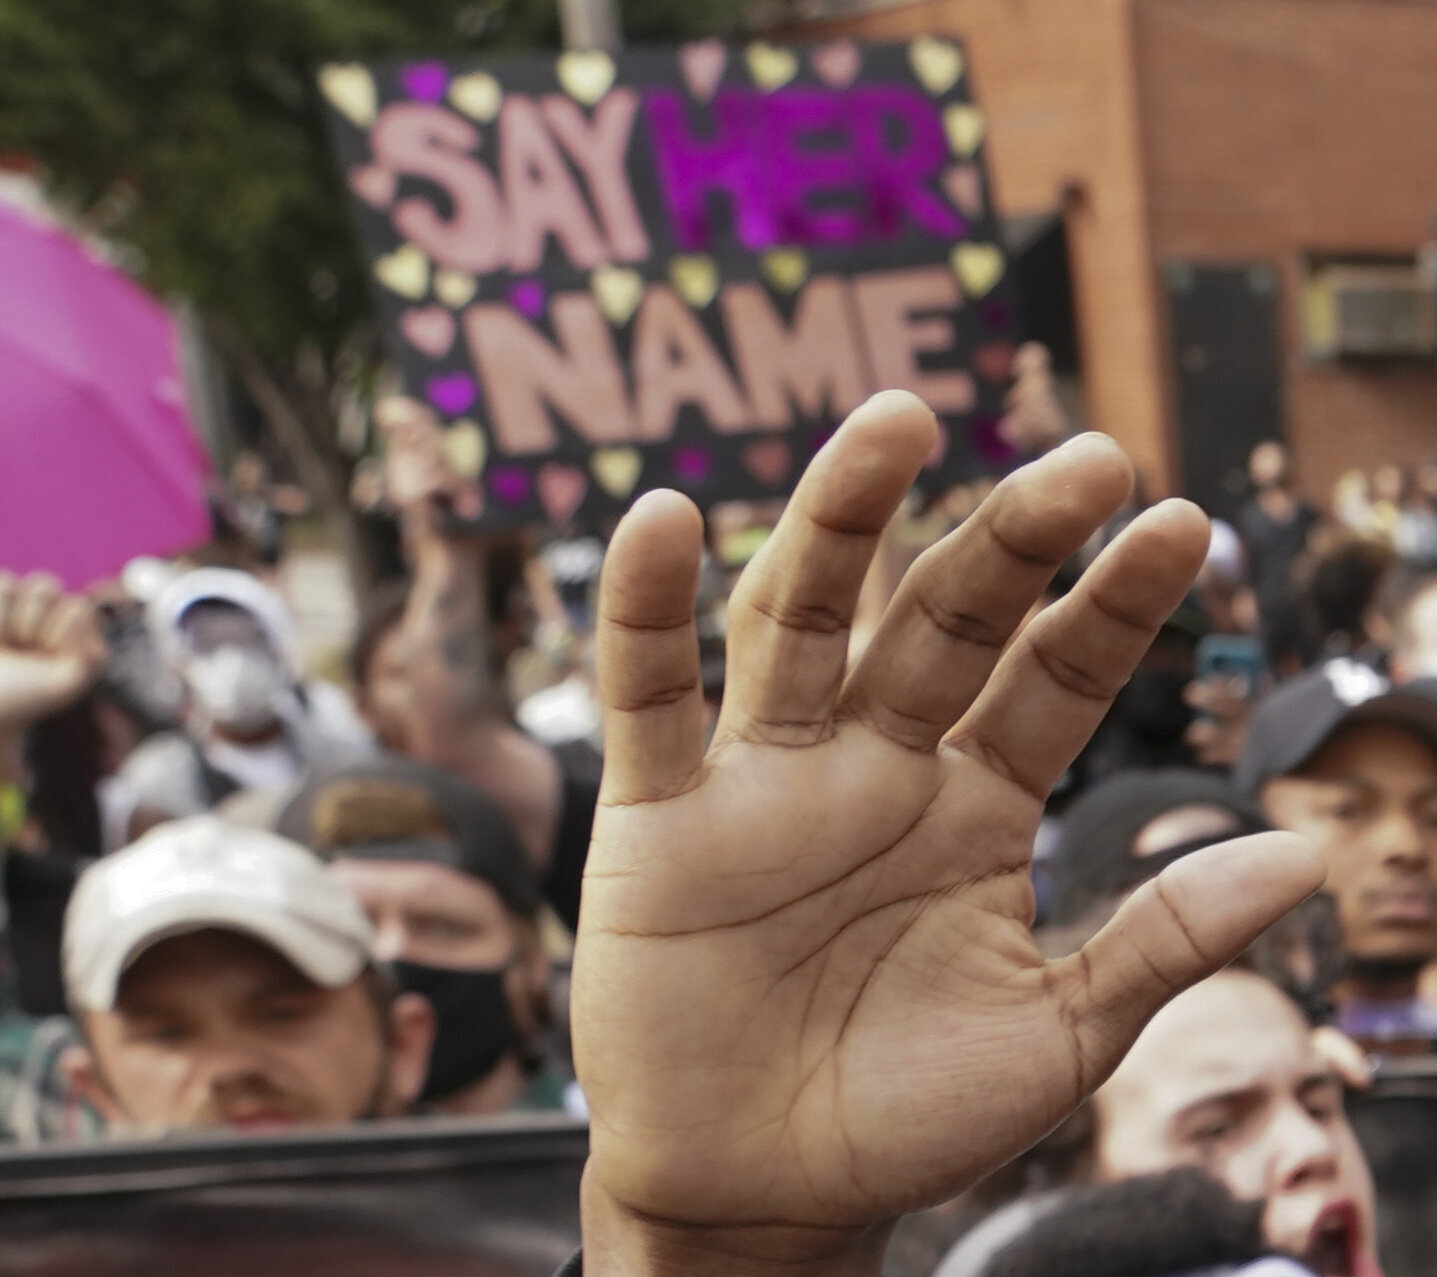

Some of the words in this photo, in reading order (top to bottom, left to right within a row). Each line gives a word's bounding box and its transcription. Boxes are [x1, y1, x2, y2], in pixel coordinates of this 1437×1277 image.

[372, 86, 648, 272] SAY
[644, 86, 966, 250] HER
[465, 267, 975, 455] NAME
